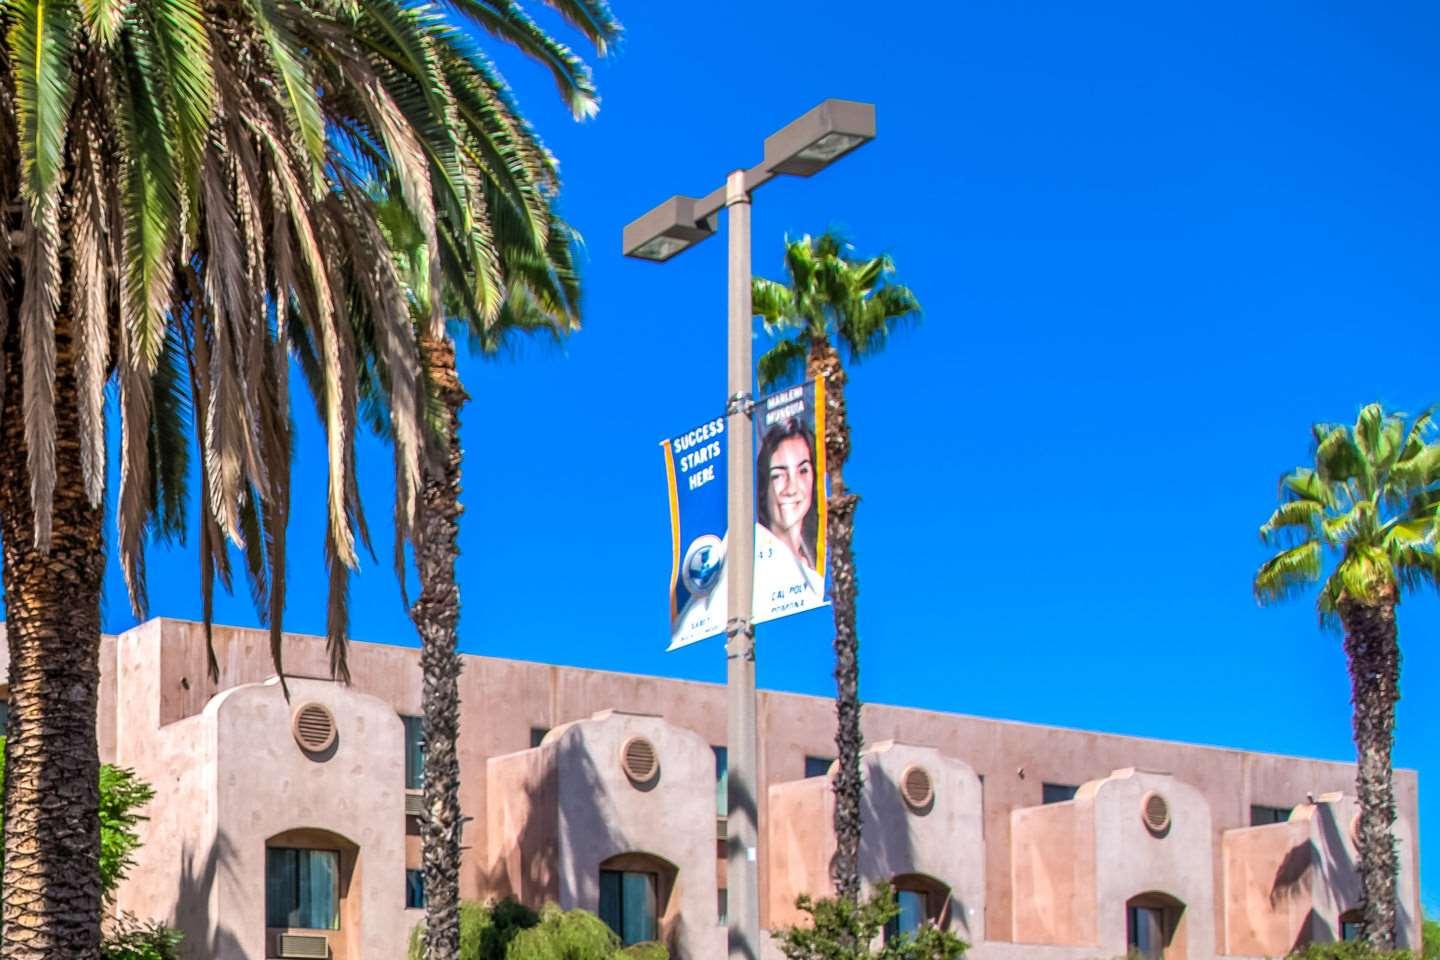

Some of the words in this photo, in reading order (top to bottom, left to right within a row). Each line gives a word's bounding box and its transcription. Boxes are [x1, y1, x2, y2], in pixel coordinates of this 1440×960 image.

[674, 417, 724, 453] SUCCESS
[681, 441, 720, 472] STARTS
[689, 465, 715, 490] HERE
